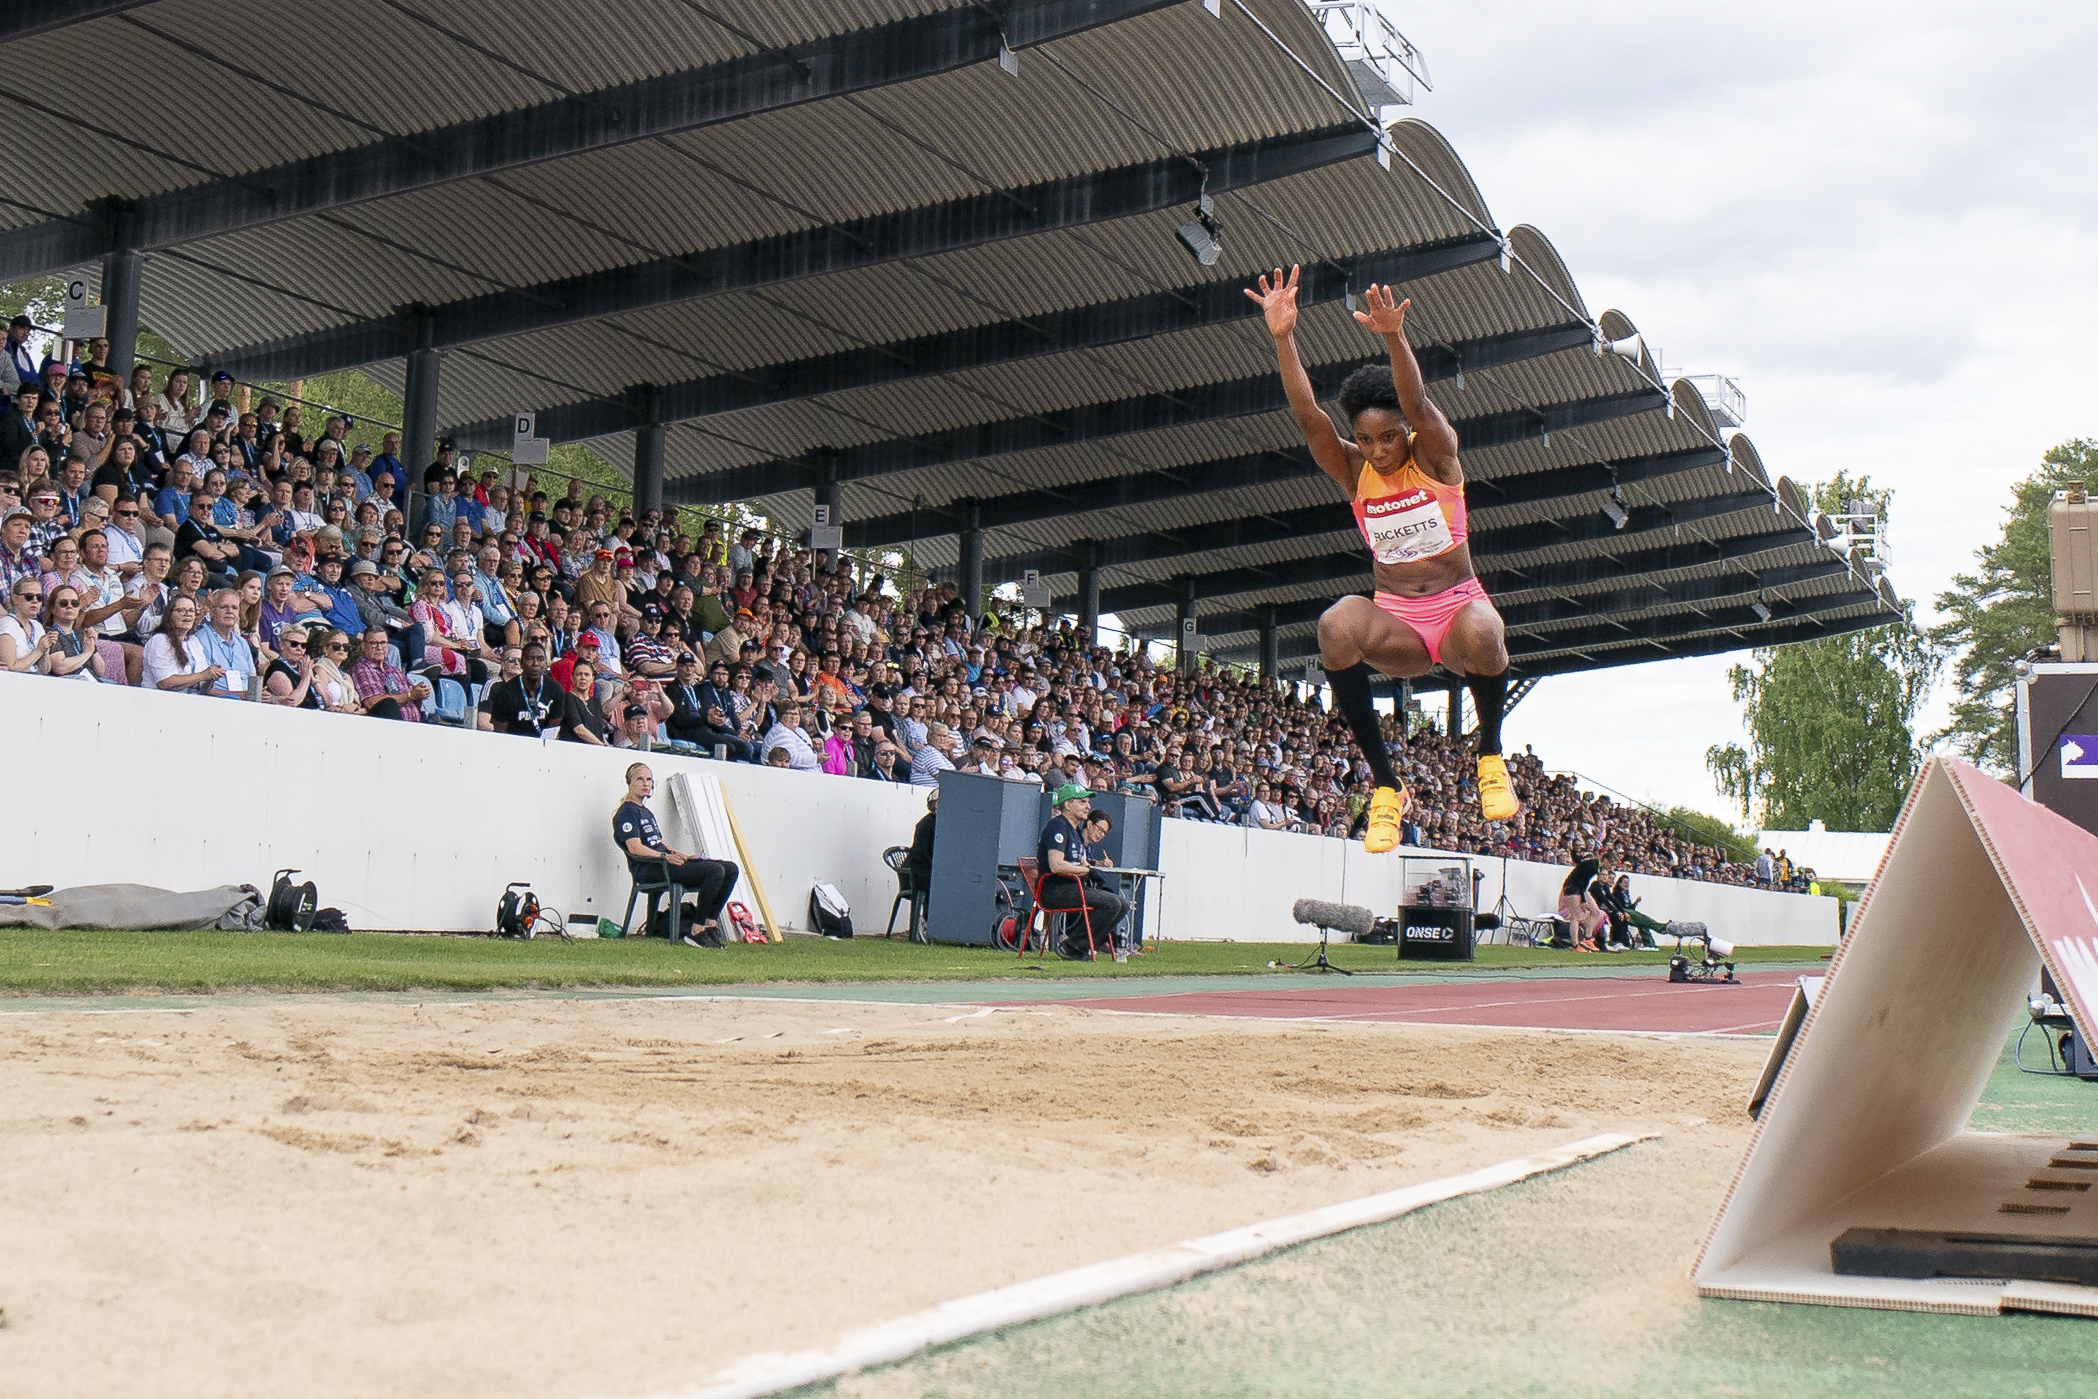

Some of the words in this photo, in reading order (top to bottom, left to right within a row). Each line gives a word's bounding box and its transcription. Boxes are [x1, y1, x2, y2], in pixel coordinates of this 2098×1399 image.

[68, 280, 84, 300] C
[517, 417, 531, 434] D
[815, 509, 826, 523] E
[1373, 518, 1438, 542] RICKETTS
[1027, 573, 1036, 585] F
[1185, 621, 1195, 632] G
[1307, 657, 1316, 669] H
[518, 709, 546, 721] PUA
[1406, 926, 1441, 939] ONSE
